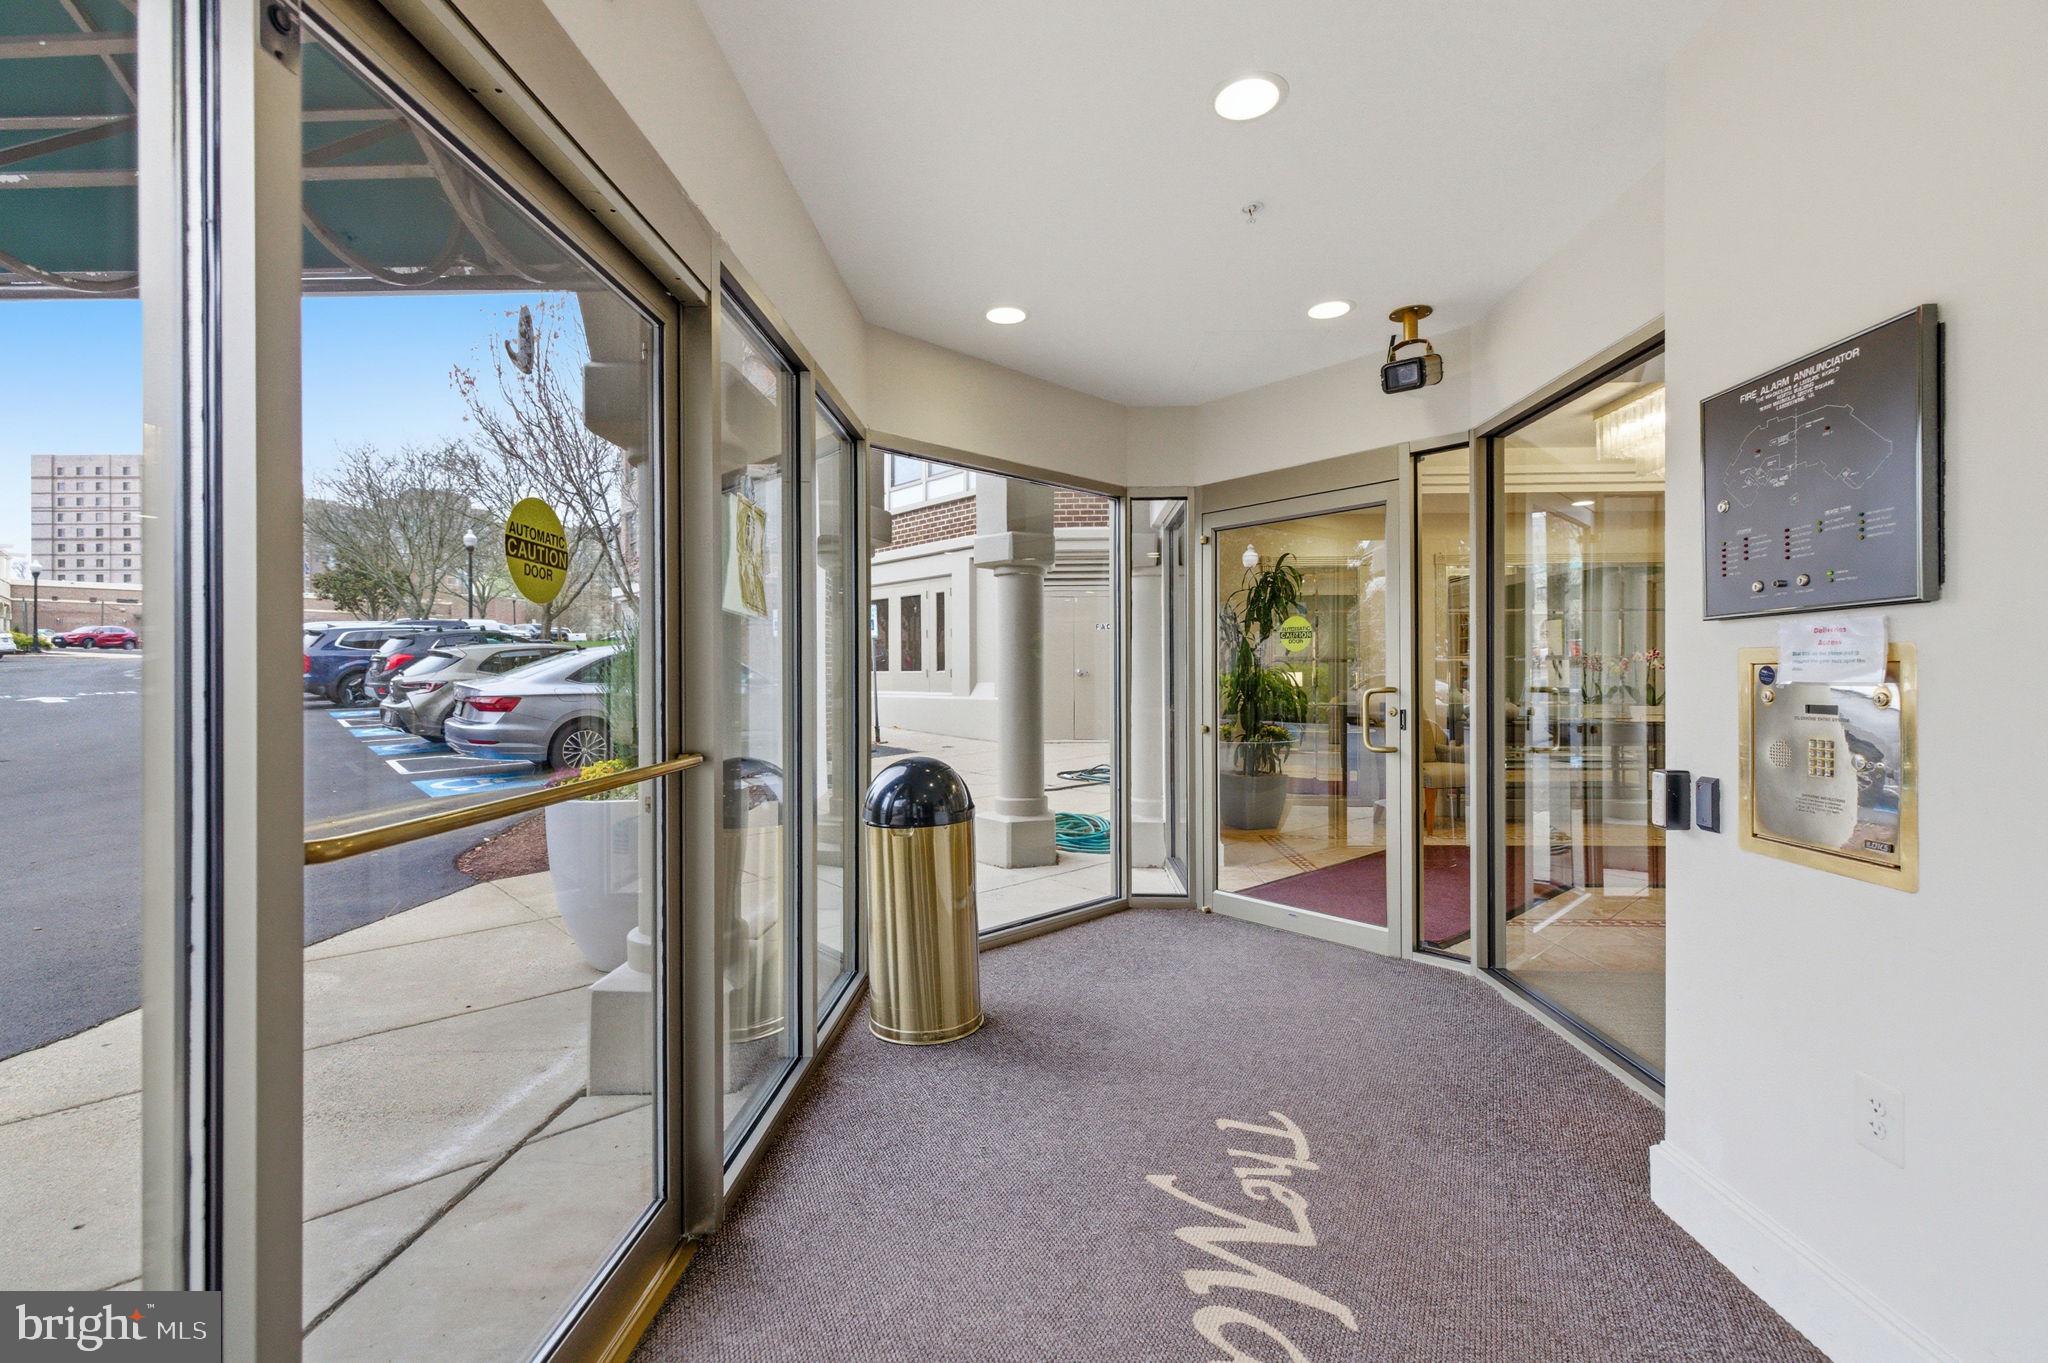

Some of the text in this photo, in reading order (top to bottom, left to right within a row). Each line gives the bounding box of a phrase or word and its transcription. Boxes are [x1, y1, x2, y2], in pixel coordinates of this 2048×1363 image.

[1740, 389, 1757, 404] FIRE
[1760, 376, 1790, 395] ALARM
[1793, 347, 1860, 382] ANNUNCIATOR
[509, 521, 565, 549] AUTOMATIC
[507, 538, 567, 569] CAUTION
[524, 563, 553, 581] DOOR
[1280, 631, 1312, 639] CAUTION
[1214, 1109, 1319, 1212] The
